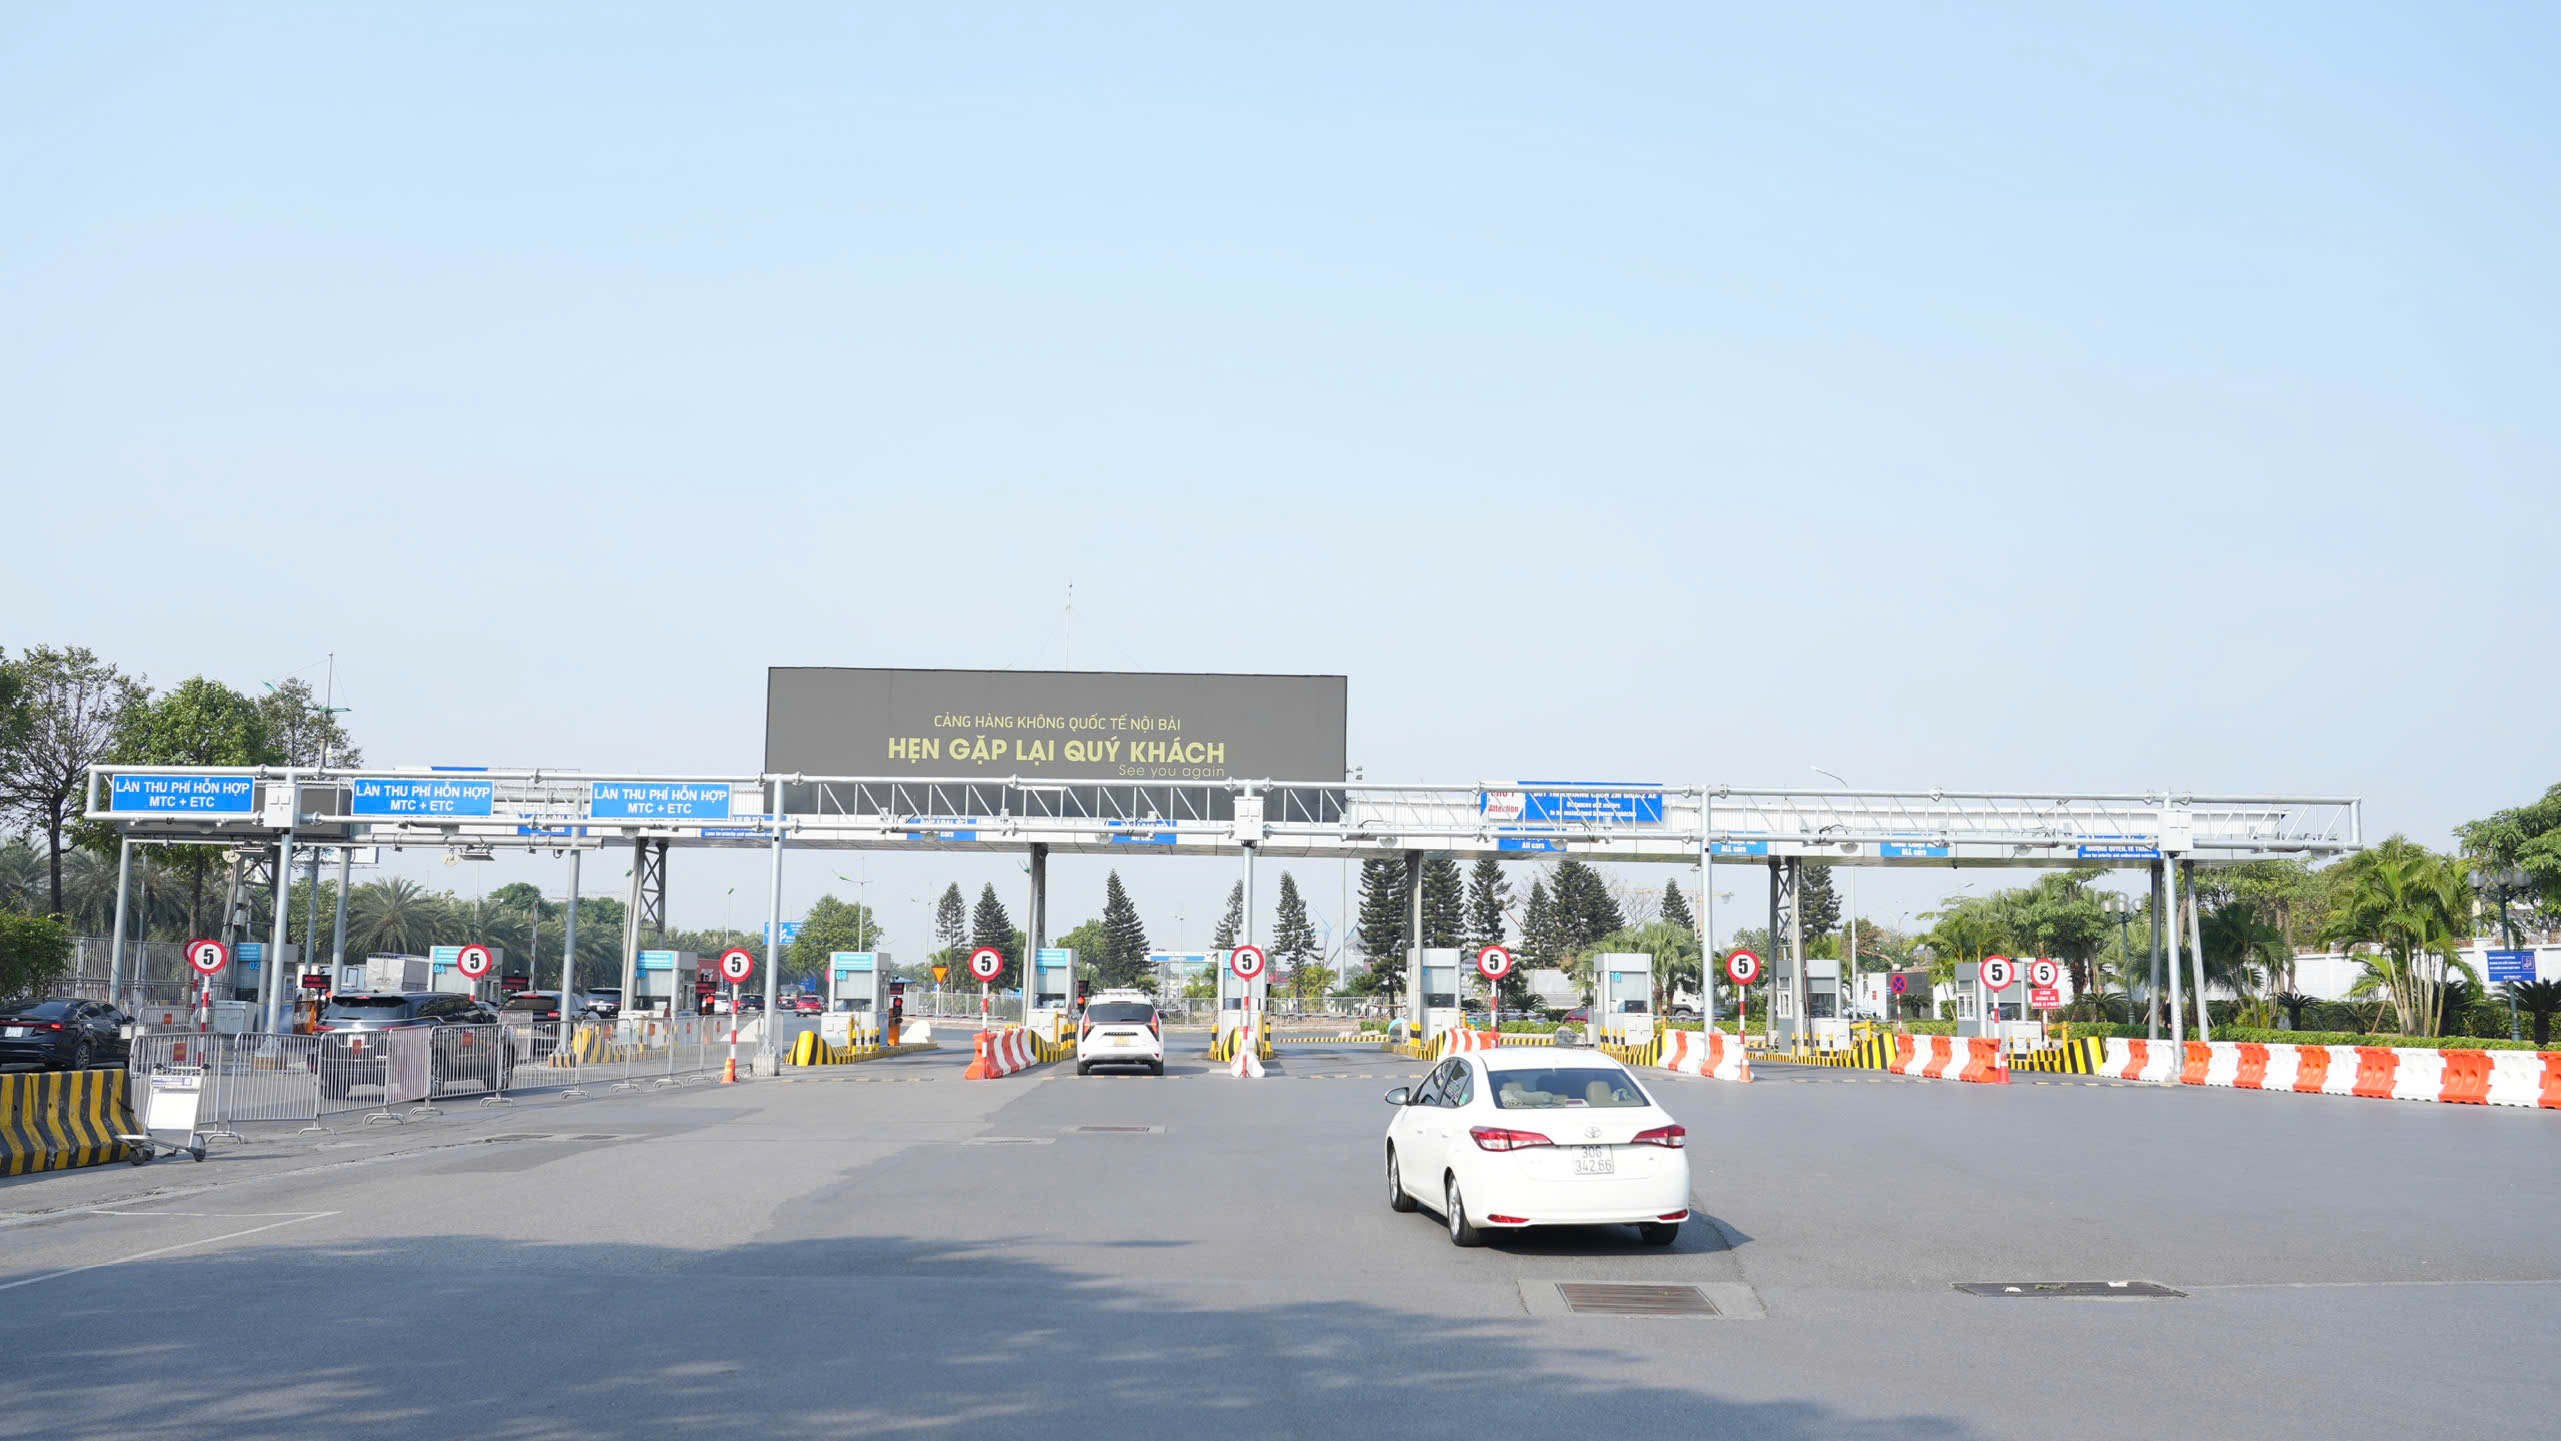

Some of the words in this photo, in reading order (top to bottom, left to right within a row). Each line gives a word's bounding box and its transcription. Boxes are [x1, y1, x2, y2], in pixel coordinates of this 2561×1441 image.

[934, 712, 971, 728] CẢNG
[975, 713, 1013, 729] HÀNG
[1017, 714, 1065, 729] KHÔNG
[1069, 713, 1106, 732] QUỐC
[1110, 713, 1127, 730] TẾ
[1130, 716, 1154, 733] NỘI
[1158, 715, 1181, 731] BÀI
[888, 737, 940, 764] HẸN
[949, 734, 1008, 765] GẶP
[1016, 739, 1055, 766] LẠI
[1064, 736, 1120, 763] QUÝ
[1130, 737, 1225, 764] KHÁCH
[1119, 765, 1145, 776] See
[1150, 767, 1176, 779] you
[1182, 767, 1225, 780] again
[116, 779, 140, 793] LÀN
[144, 781, 168, 793] THU
[171, 780, 190, 794] PHÍ
[194, 778, 220, 794] HỖN
[223, 782, 250, 797] HỢP
[356, 782, 380, 797] LÀN
[384, 785, 408, 797] THU
[412, 784, 431, 798] PHÍ
[434, 782, 461, 798] HỖN
[463, 786, 491, 801] HỢP
[594, 786, 618, 800] LÀN
[622, 788, 645, 800] THU
[649, 787, 668, 801] PHÍ
[671, 785, 697, 801] HỖN
[701, 789, 727, 804] HỢP
[149, 796, 176, 807] MTC
[190, 796, 215, 808] ETC
[390, 800, 416, 811] MTC
[430, 800, 454, 811] ETC
[628, 803, 654, 814] MTC
[667, 803, 692, 814] ETC
[203, 948, 214, 965] 5
[469, 952, 480, 969] 5
[731, 956, 742, 973] 5
[981, 955, 992, 972] 5
[1242, 953, 1252, 970] 5
[1489, 954, 1499, 970] 5
[249, 961, 261, 971] 02
[1738, 958, 1748, 975] 5
[1991, 963, 2003, 981] 5
[2040, 965, 2049, 981] 5
[1610, 972, 1621, 982] 16
